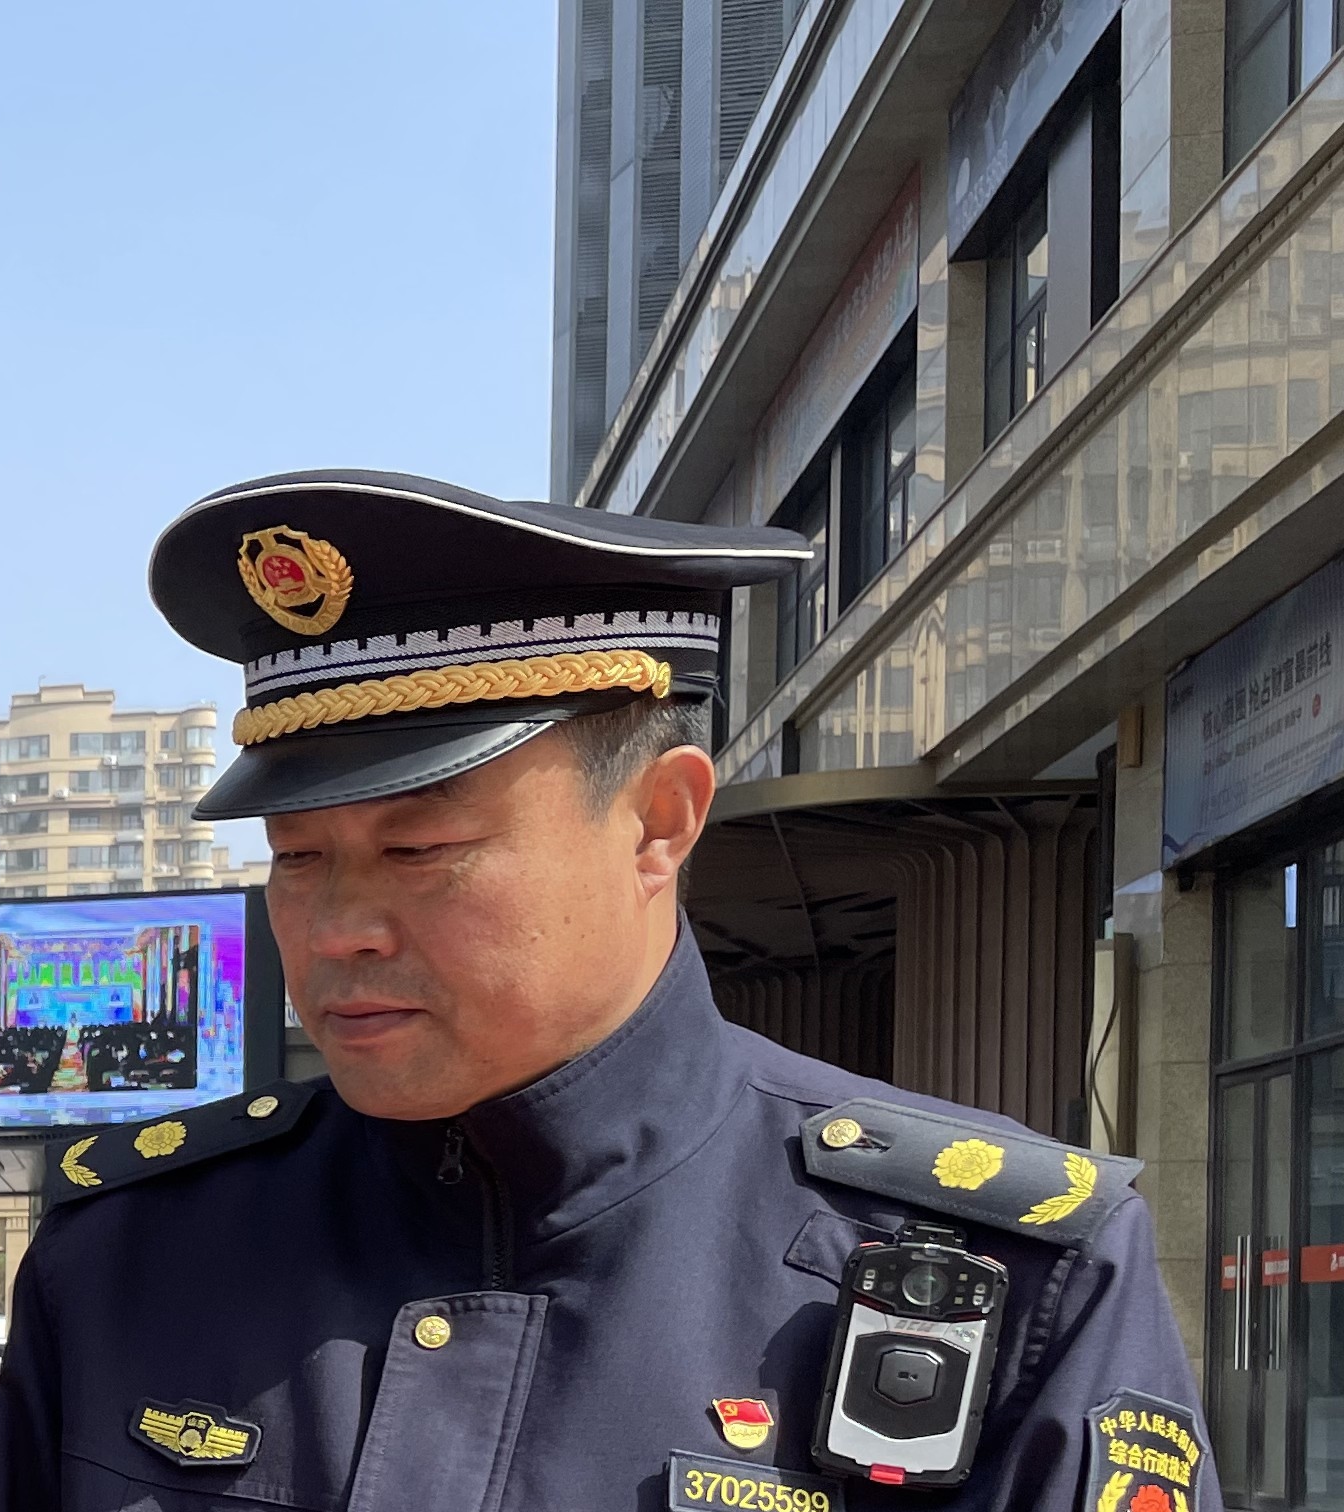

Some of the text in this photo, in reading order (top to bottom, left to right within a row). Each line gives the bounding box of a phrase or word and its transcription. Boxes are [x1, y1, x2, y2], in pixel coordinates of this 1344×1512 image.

[1099, 1410, 1200, 1467] 中华人民共和国
[1108, 1438, 1191, 1488] 综合行政执法
